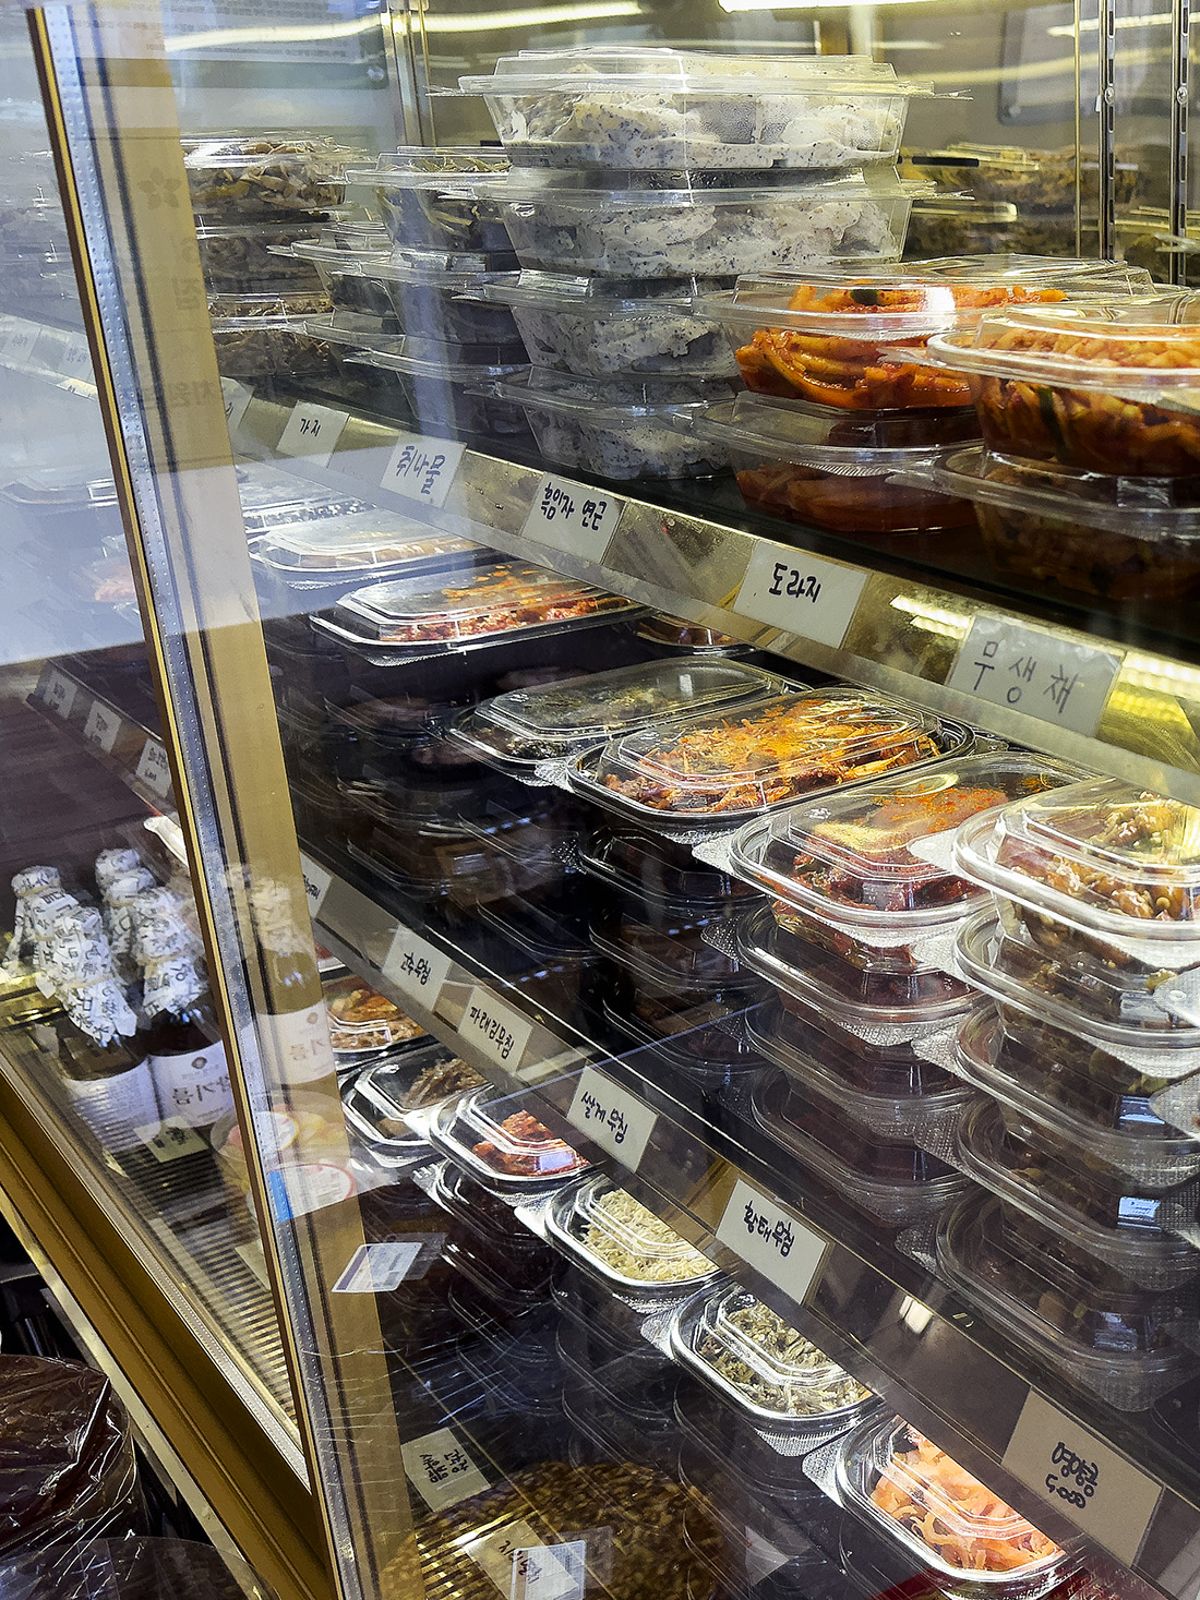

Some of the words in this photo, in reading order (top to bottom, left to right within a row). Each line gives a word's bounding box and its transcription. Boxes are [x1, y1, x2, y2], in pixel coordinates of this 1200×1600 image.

[300, 418, 323, 438] 가지
[396, 445, 446, 495] 취나물
[541, 482, 575, 520] 흑임자
[582, 499, 607, 531] 연근
[768, 562, 821, 603] 도라지
[974, 641, 1079, 714] 무생채
[470, 1006, 515, 1060] 파래김무침
[744, 1200, 795, 1257] 황태무침
